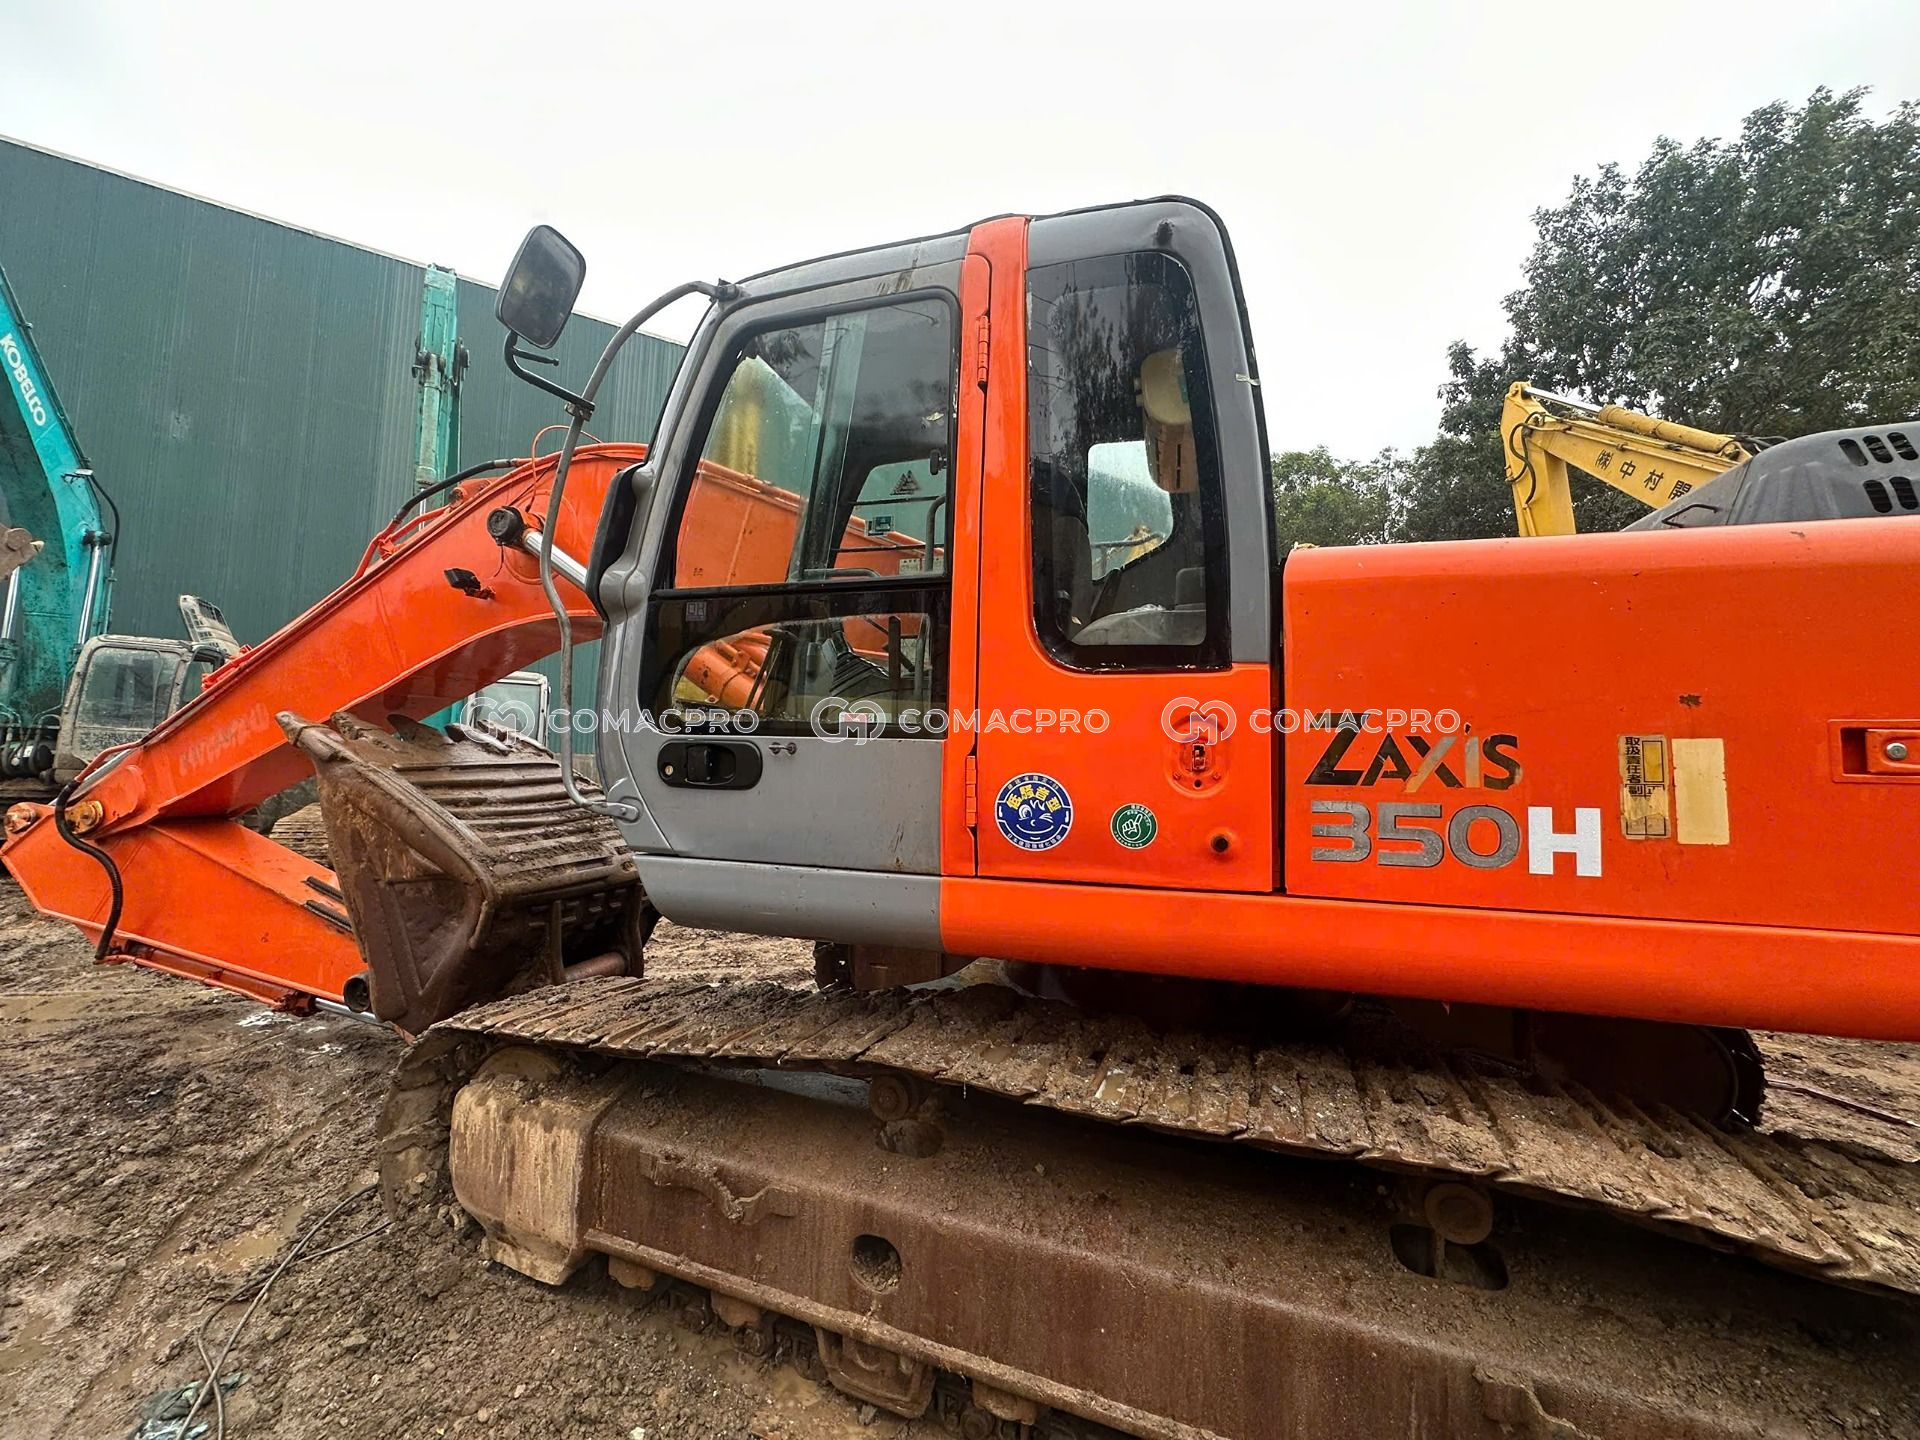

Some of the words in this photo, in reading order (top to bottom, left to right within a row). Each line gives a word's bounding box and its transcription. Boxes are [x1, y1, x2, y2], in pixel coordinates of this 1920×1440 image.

[1, 333, 46, 426] KOBELCO
[1625, 736, 1642, 783] 取扱責任者
